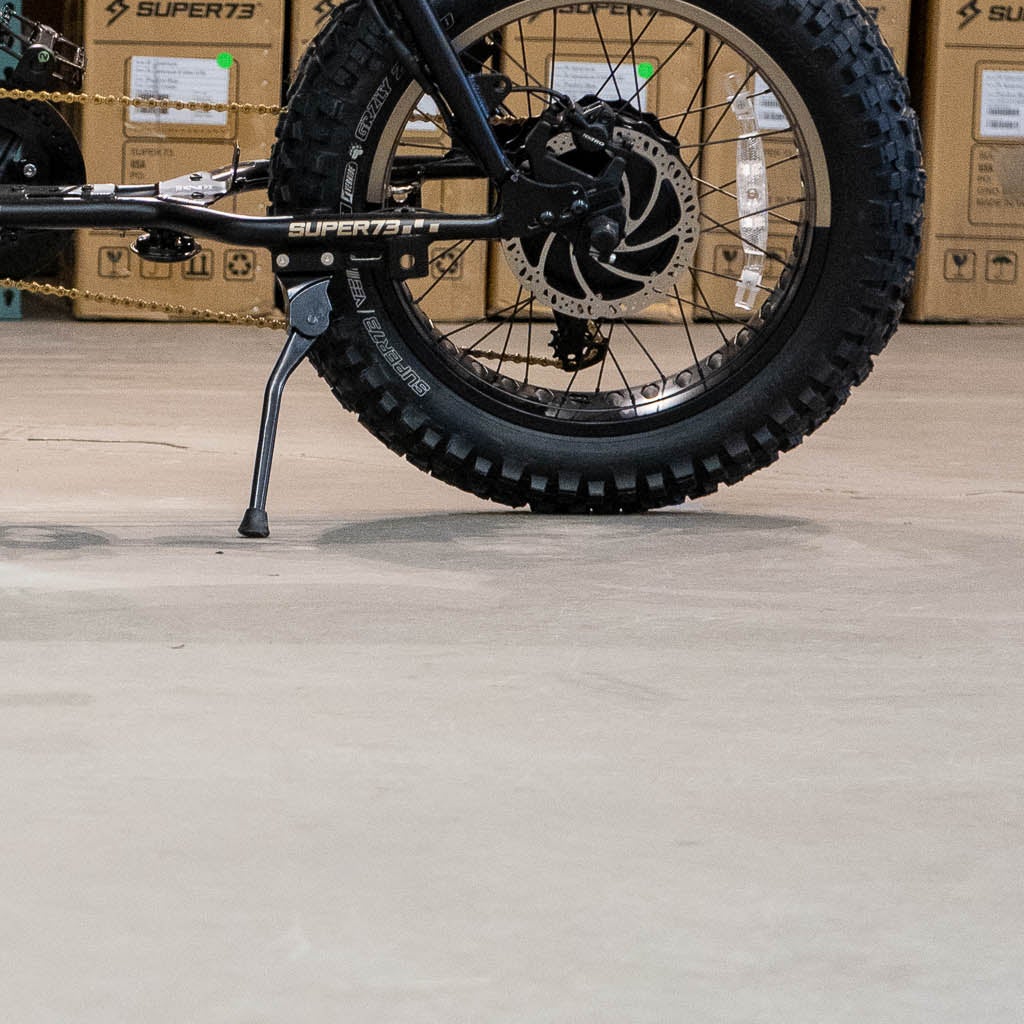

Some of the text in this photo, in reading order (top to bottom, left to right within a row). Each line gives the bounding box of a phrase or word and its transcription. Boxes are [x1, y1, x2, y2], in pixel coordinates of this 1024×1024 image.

[136, 0, 255, 19] SUPER73
[130, 160, 146, 169] USA
[288, 219, 402, 238] SUPER73
[362, 315, 431, 398] SUPER73
